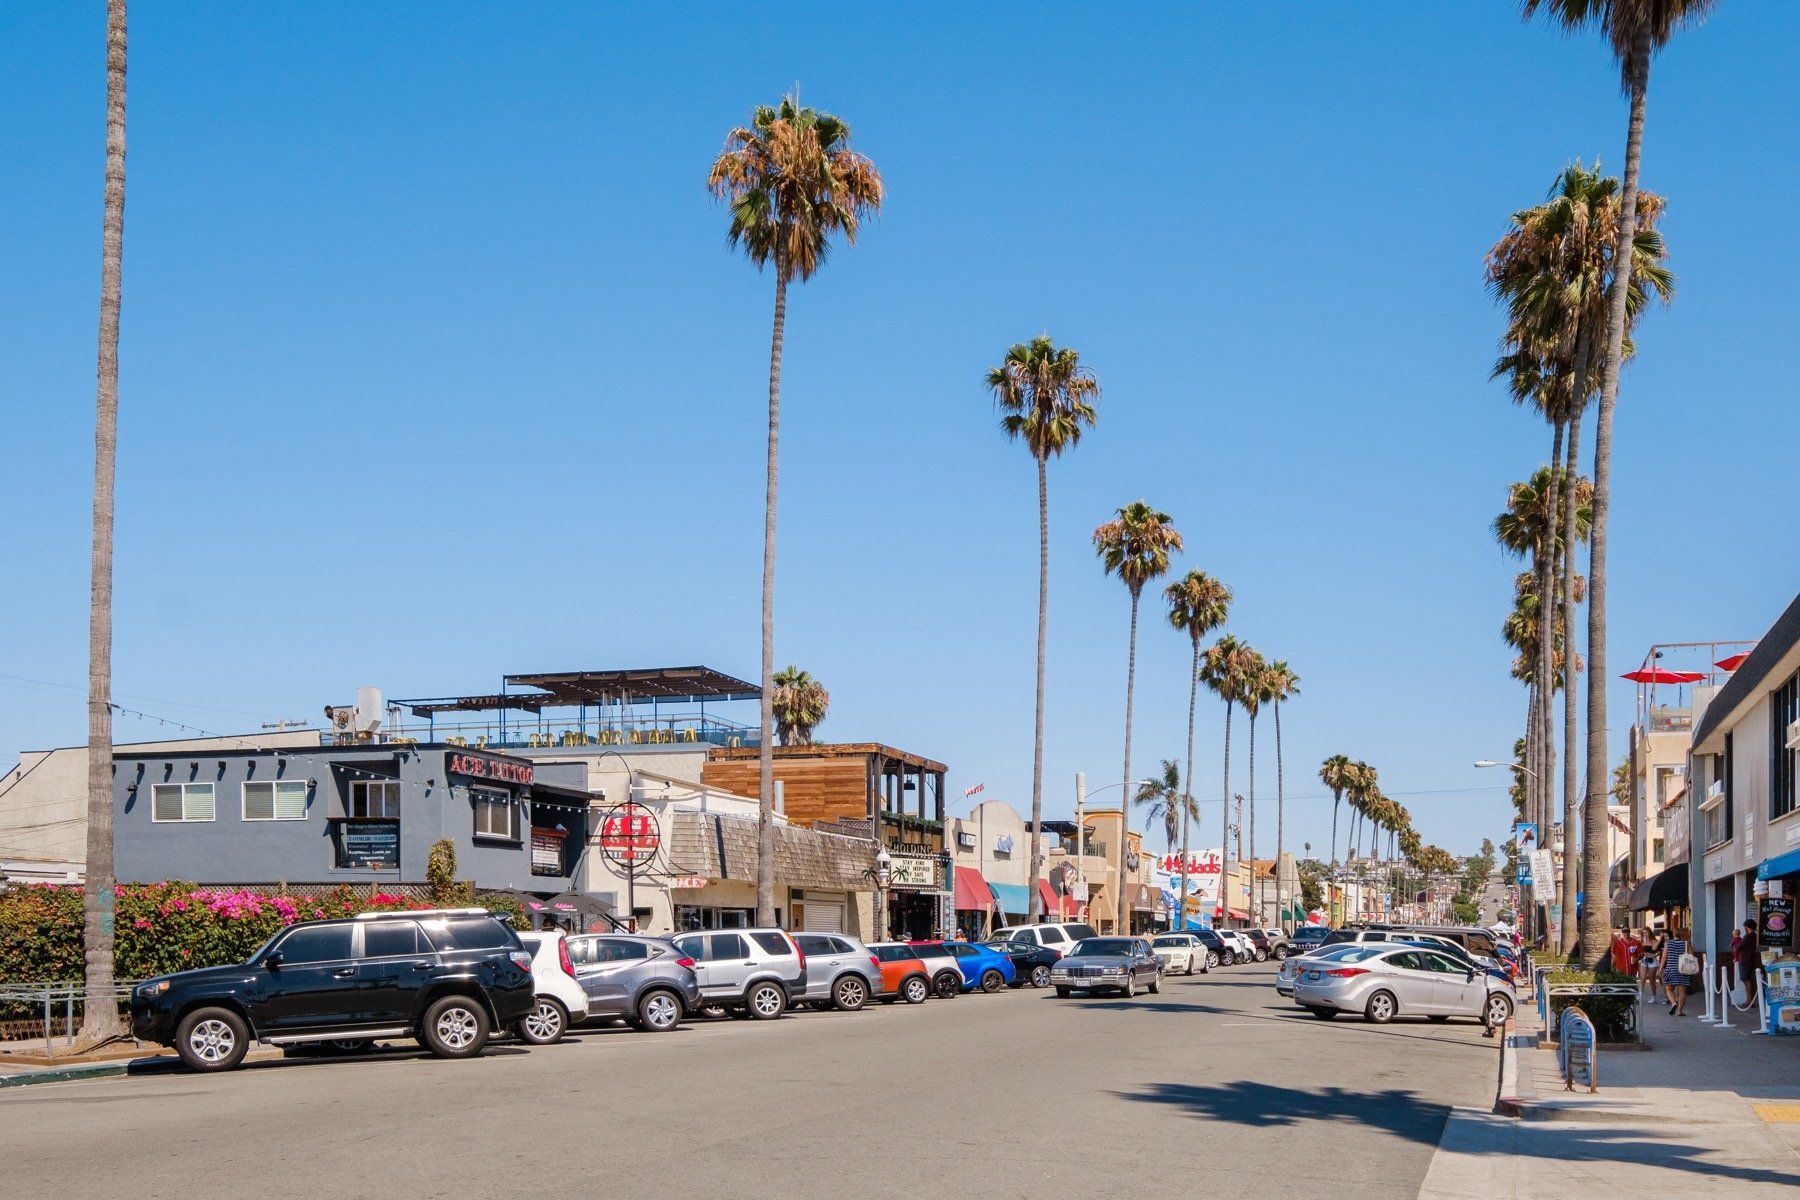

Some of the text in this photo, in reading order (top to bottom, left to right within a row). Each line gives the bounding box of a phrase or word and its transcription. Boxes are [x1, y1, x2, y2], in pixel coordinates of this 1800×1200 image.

[451, 754, 534, 785] ACE TATTOO
[892, 843, 932, 855] HOLDING
